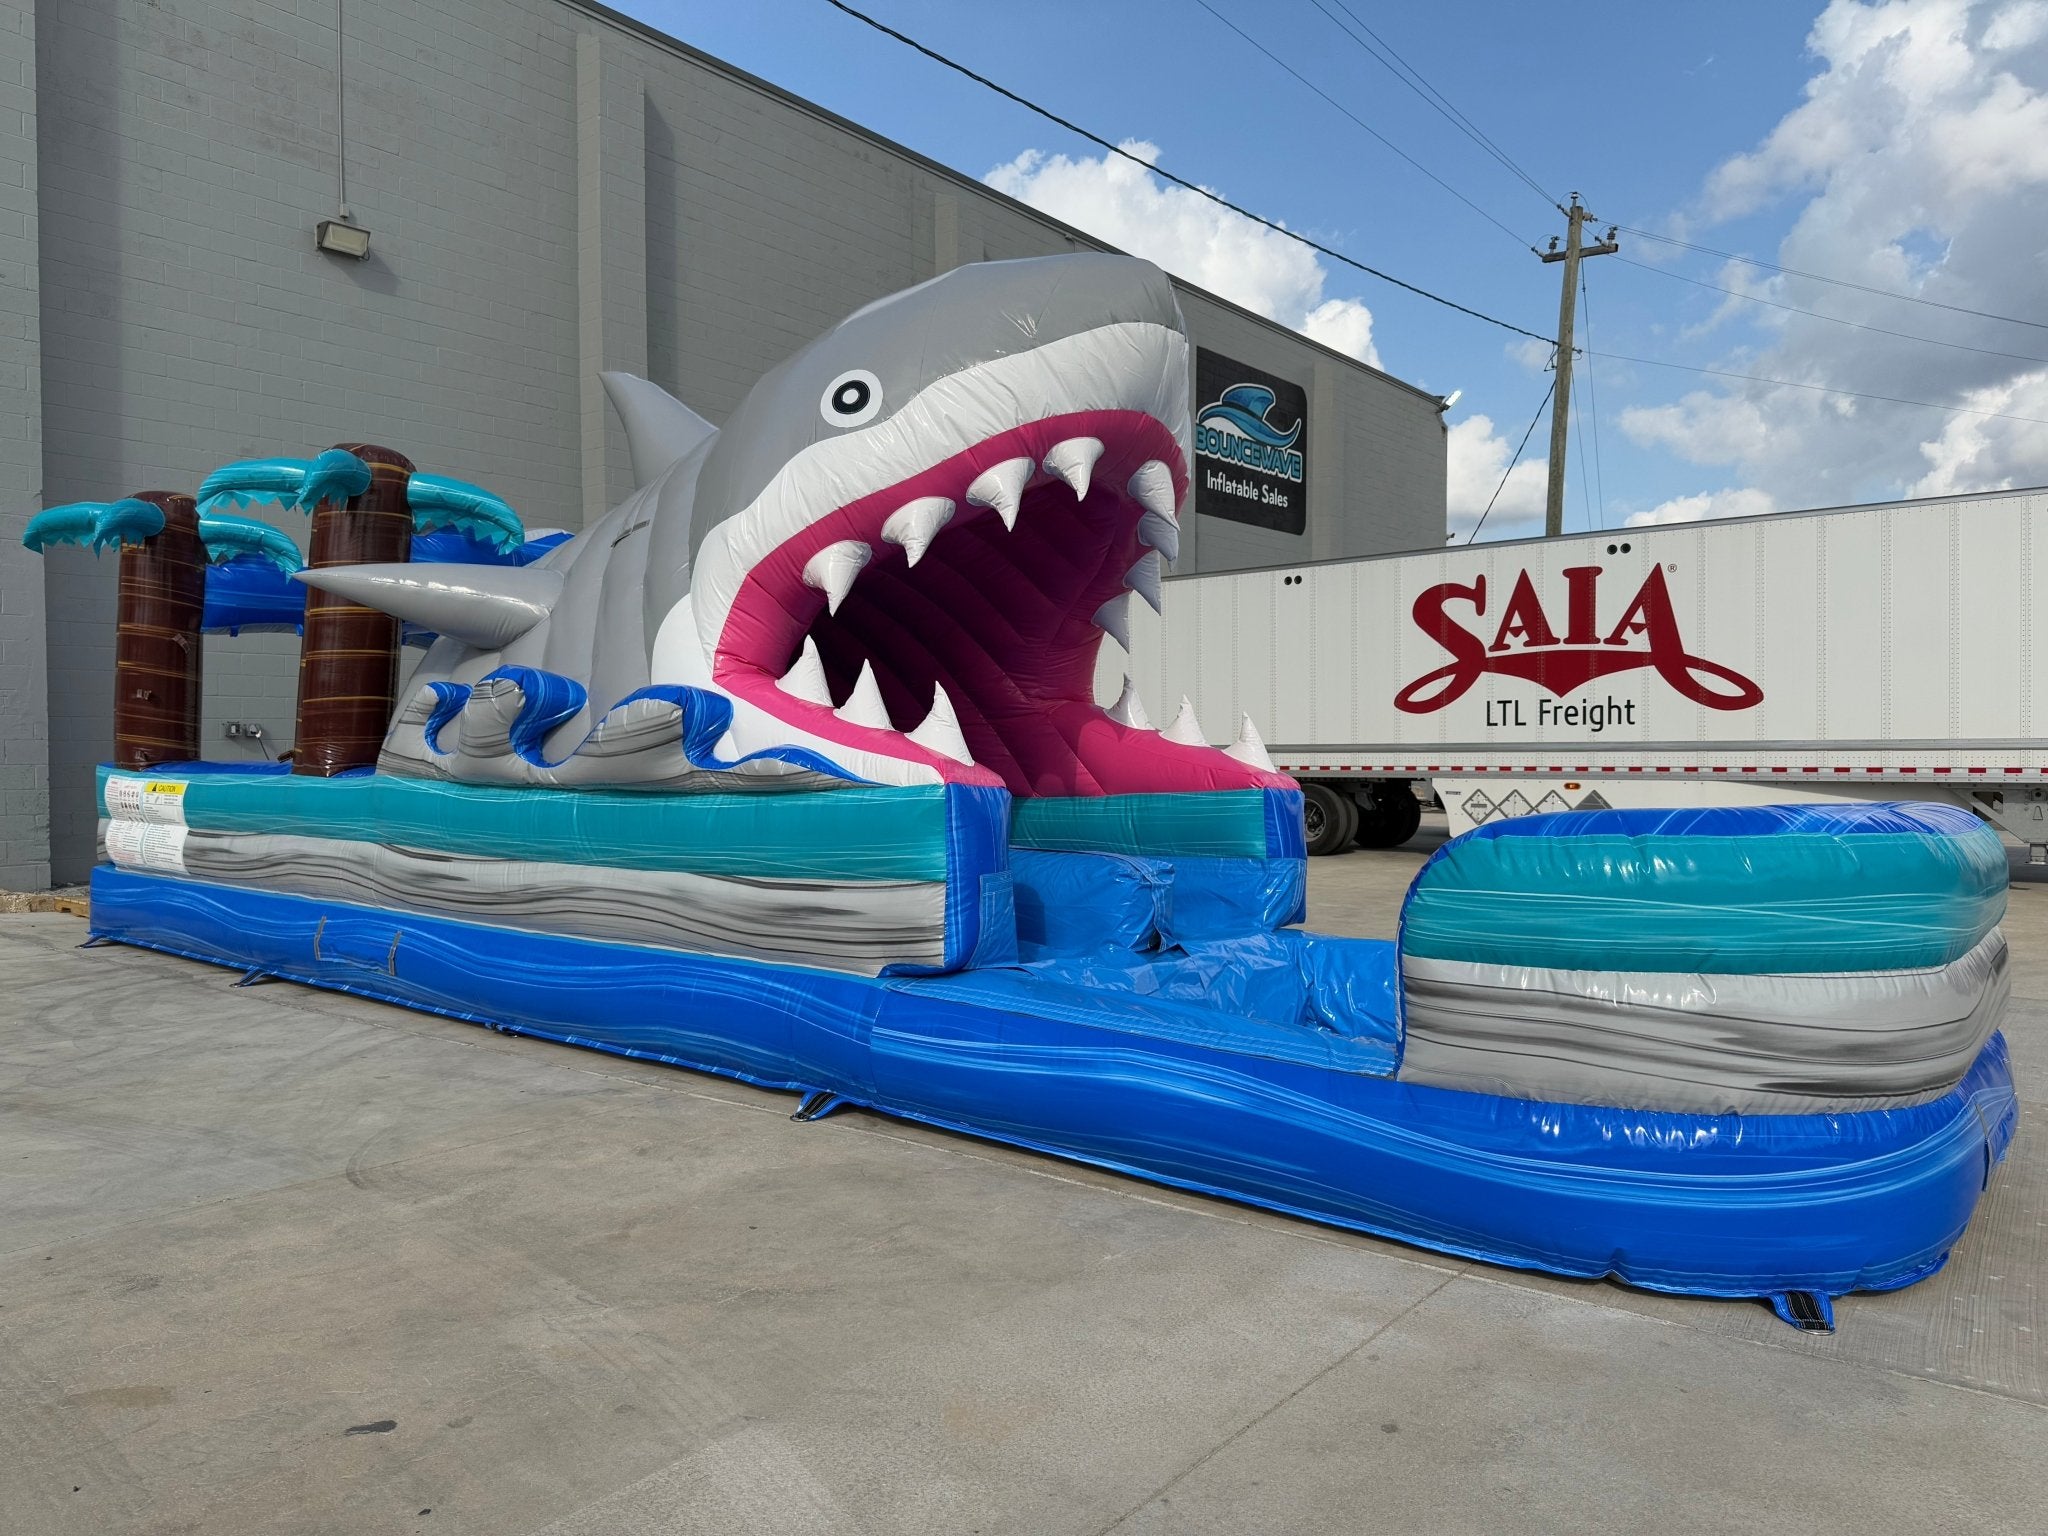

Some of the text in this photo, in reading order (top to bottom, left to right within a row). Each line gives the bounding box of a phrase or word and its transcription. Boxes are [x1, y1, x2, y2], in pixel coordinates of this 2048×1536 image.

[1196, 425, 1302, 481] BOUNCEWAVE
[1207, 469, 1289, 508] Inflatable Sales
[1394, 562, 1764, 714] SAIA
[1486, 695, 1636, 732] LTL Freight
[158, 784, 176, 792] CAUTION
